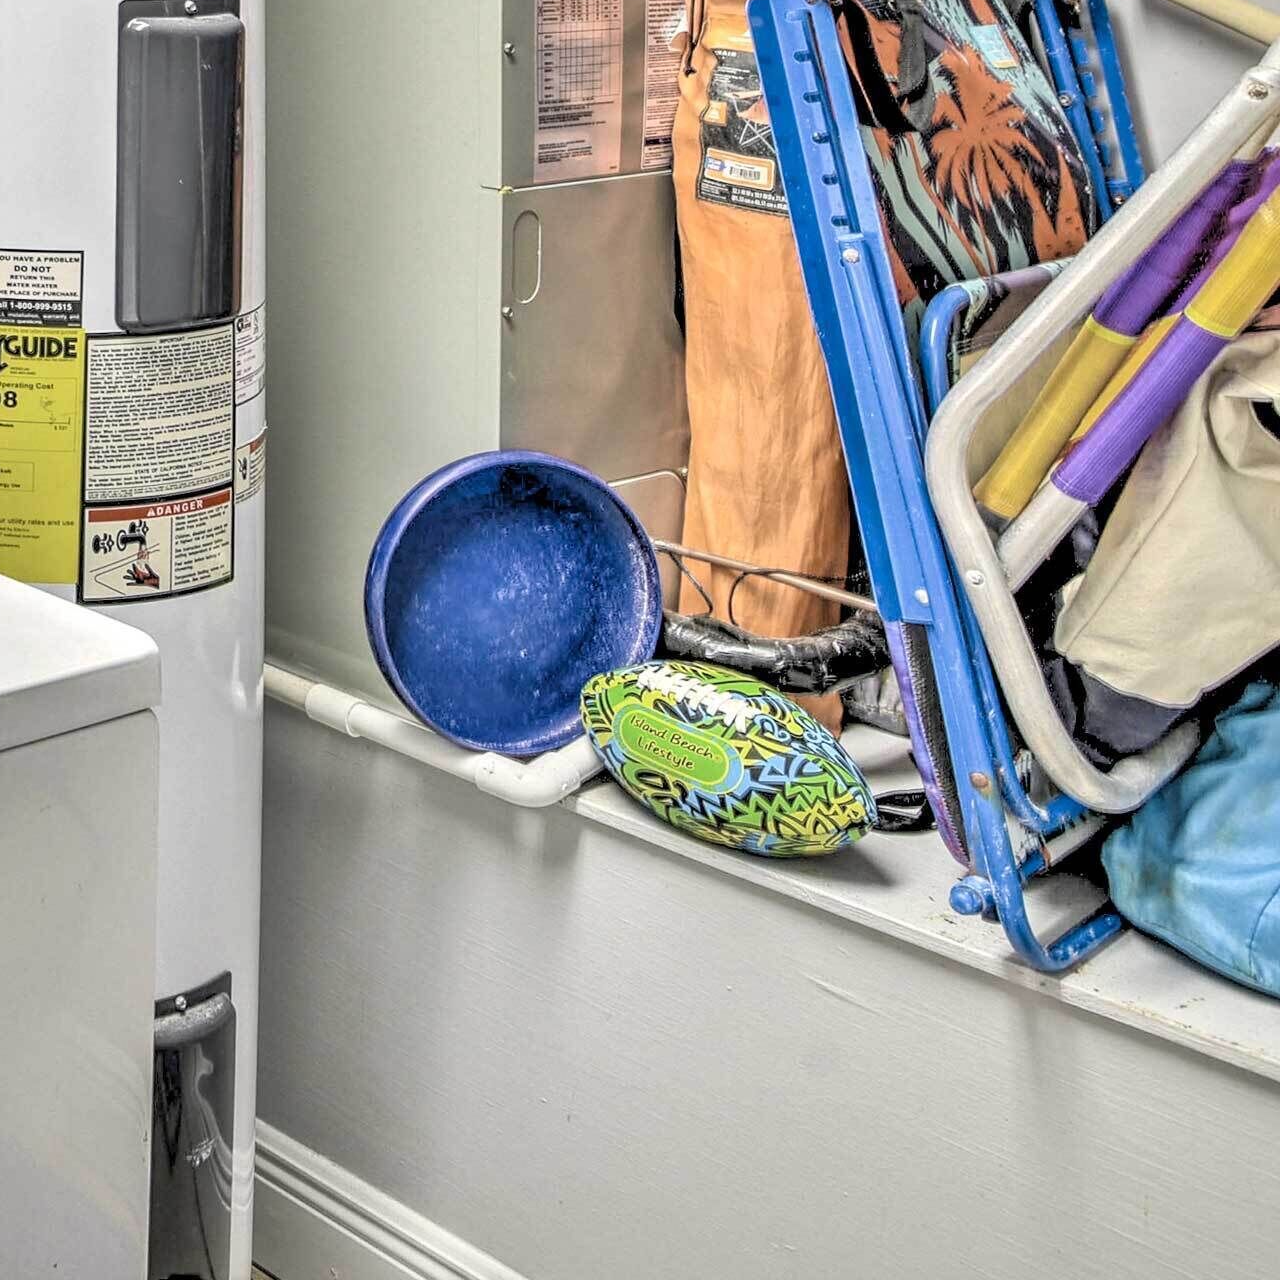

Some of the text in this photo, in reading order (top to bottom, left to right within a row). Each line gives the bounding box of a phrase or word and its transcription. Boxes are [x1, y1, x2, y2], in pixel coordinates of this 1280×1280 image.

[35, 382, 54, 390] Cost
[156, 499, 205, 516] DANGER
[7, 517, 26, 526] utility
[47, 519, 61, 527] and
[630, 714, 713, 759] Island Beach
[637, 736, 695, 770] Lifestyle
